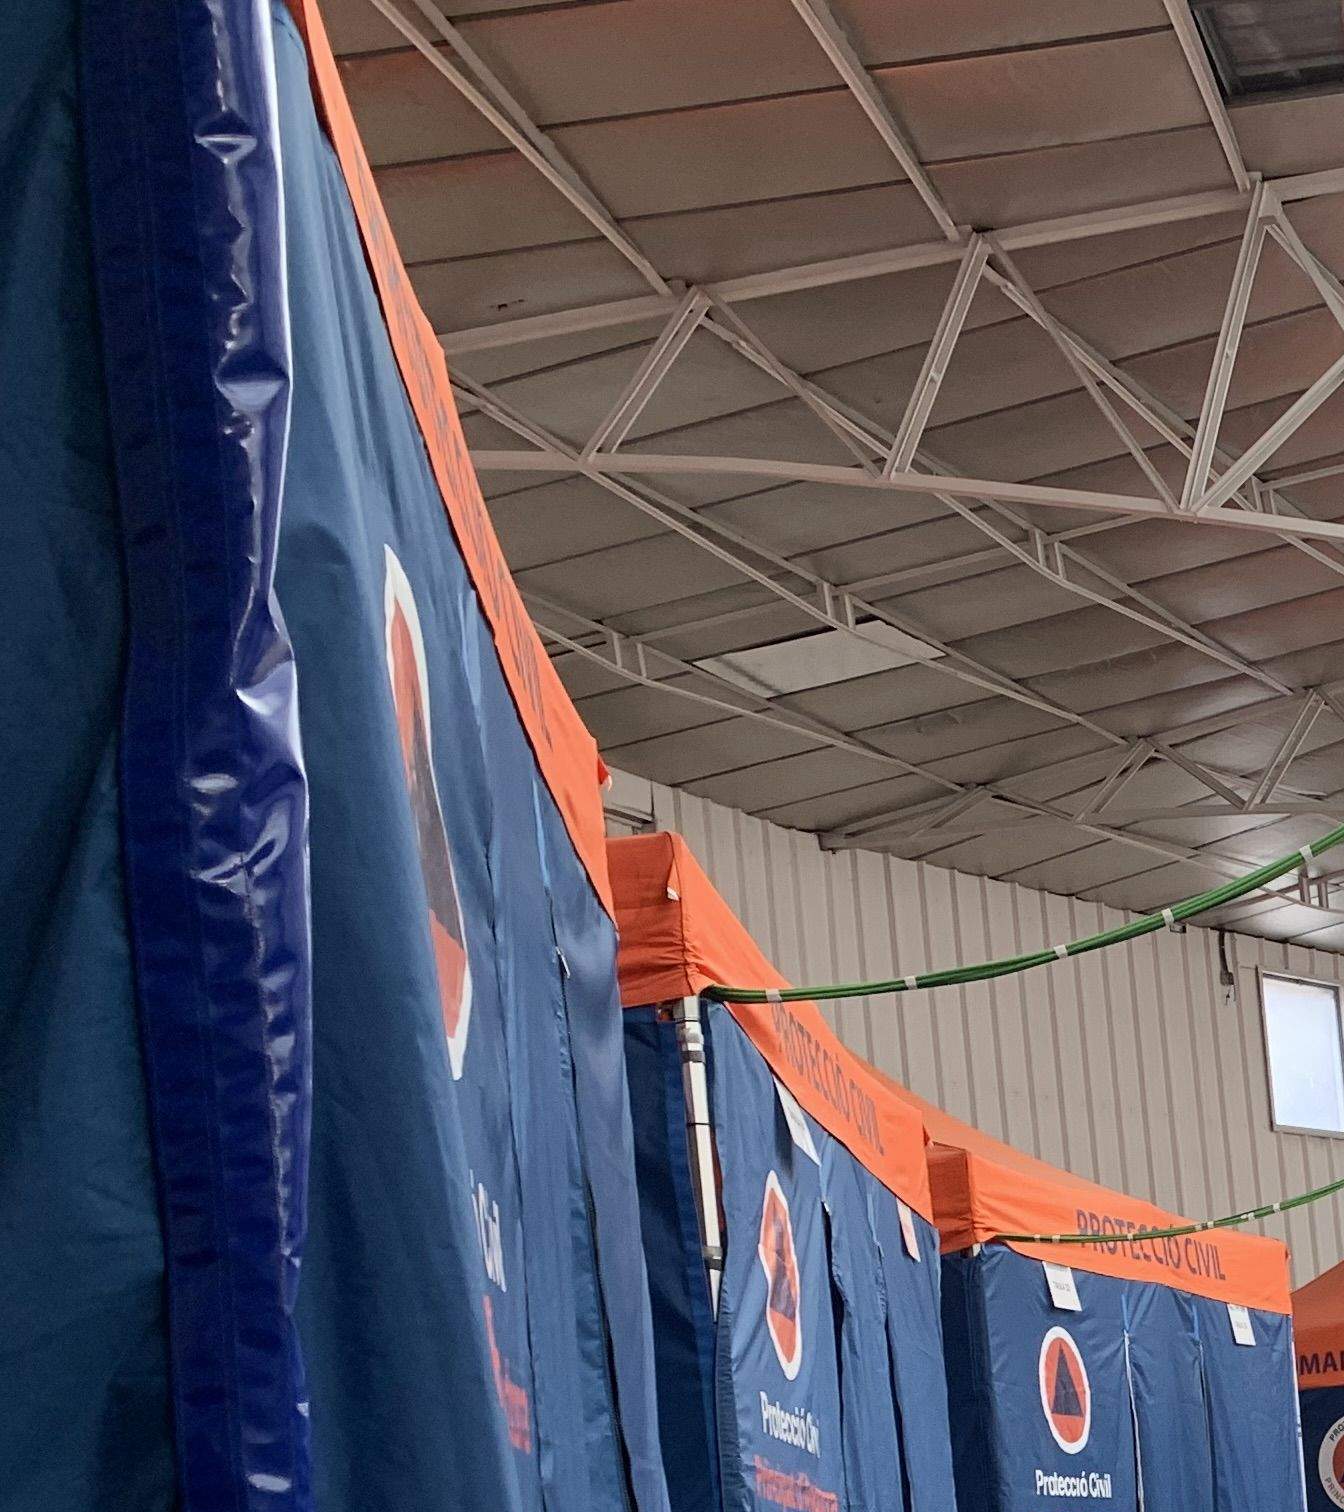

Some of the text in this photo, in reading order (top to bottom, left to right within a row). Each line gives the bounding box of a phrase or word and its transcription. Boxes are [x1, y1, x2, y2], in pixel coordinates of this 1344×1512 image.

[1076, 1209, 1226, 1280] PROTECCIÓ CIVIL
[1035, 1469, 1112, 1498] Protecció Civil
